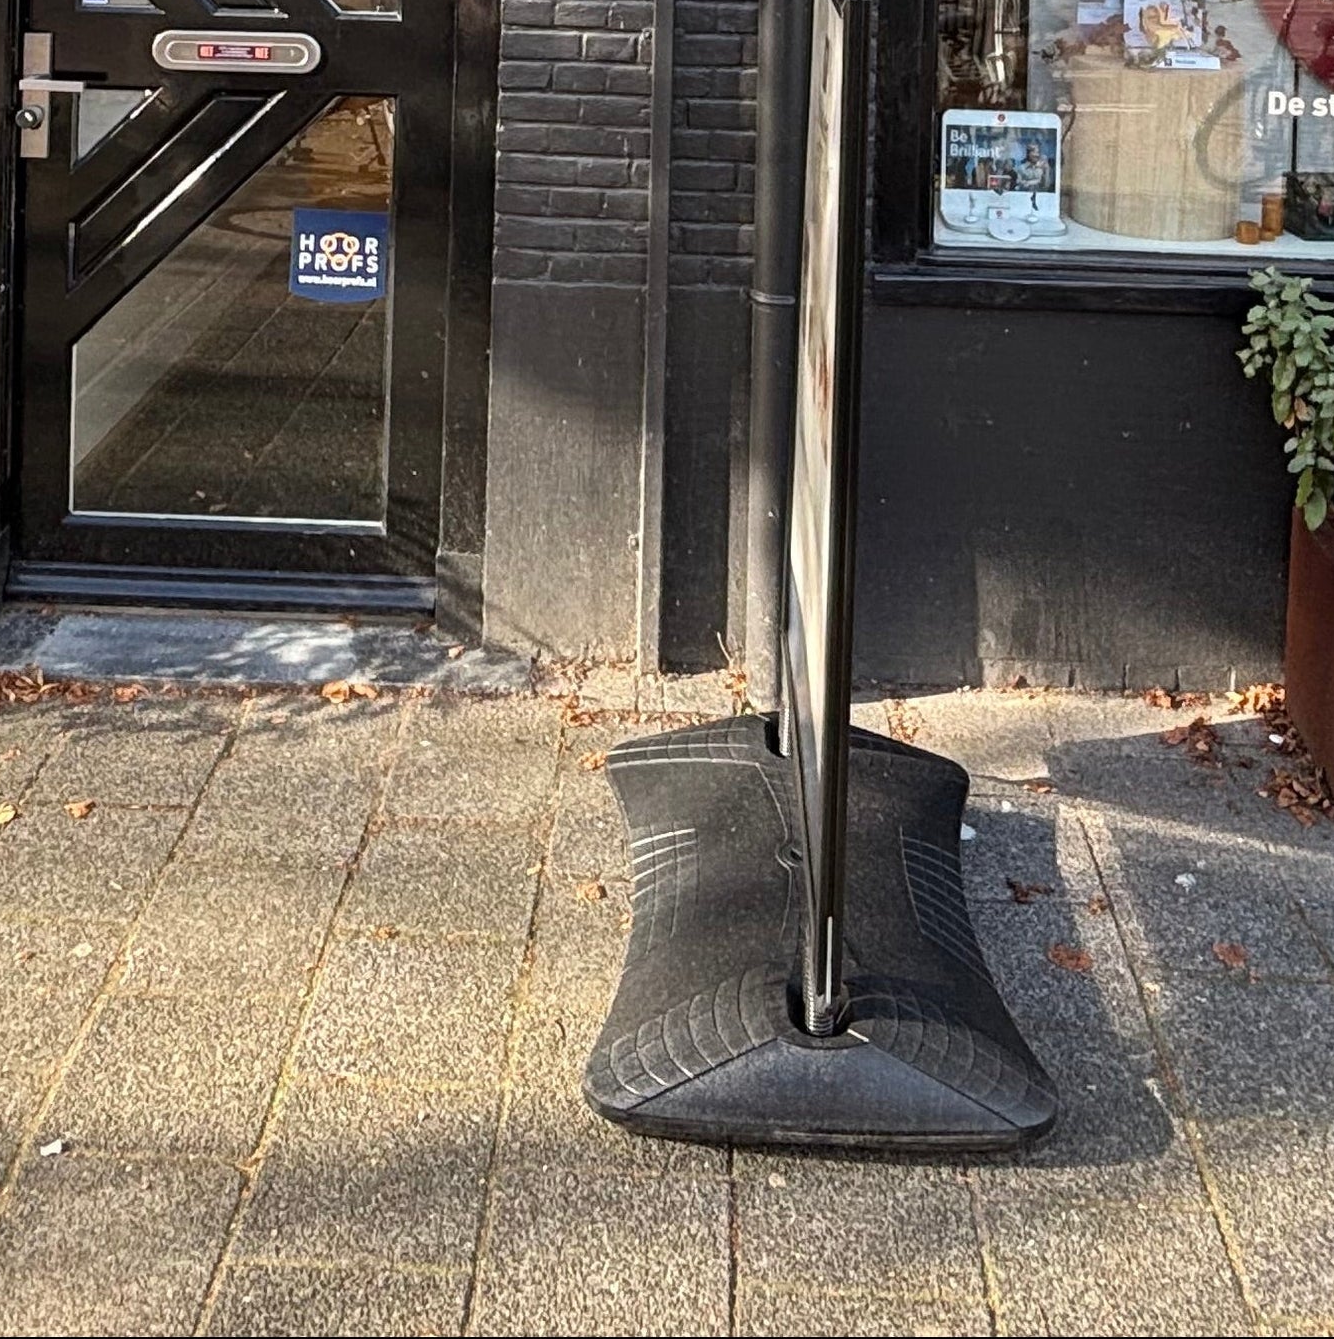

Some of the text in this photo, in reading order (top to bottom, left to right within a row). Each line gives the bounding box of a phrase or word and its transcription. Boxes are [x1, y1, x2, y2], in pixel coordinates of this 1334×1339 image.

[1267, 91, 1305, 117] De
[950, 129, 968, 143] Be
[949, 144, 1002, 158] Brilliant
[299, 233, 379, 255] HOOR
[298, 252, 379, 274] PROFS
